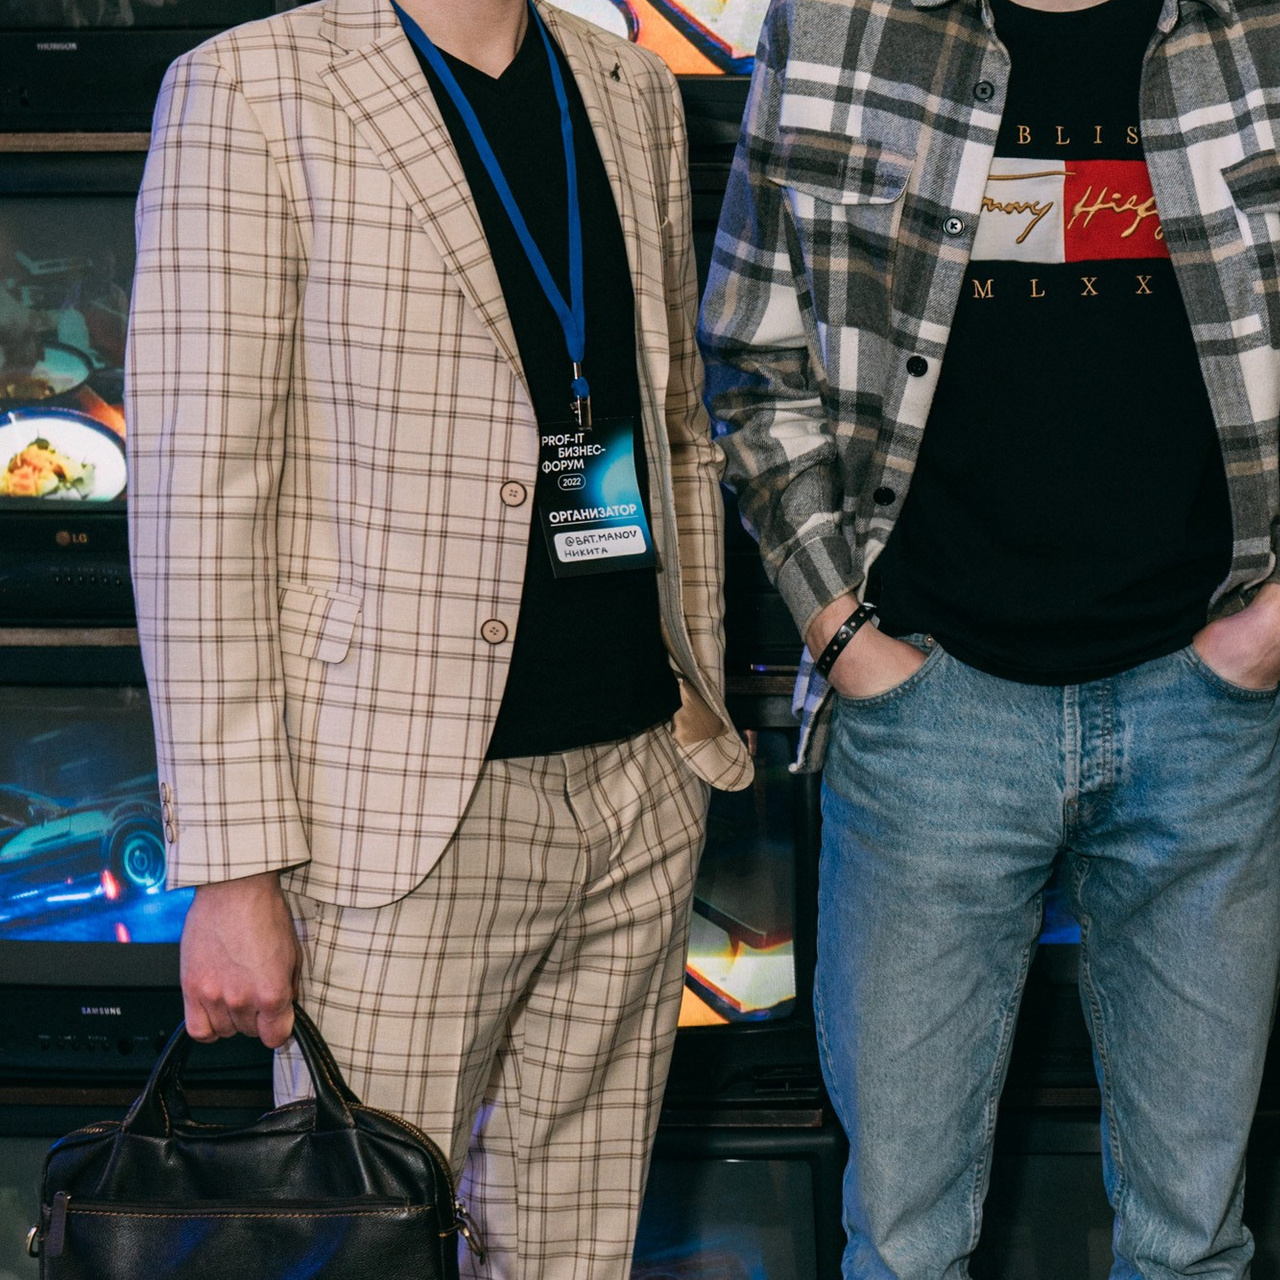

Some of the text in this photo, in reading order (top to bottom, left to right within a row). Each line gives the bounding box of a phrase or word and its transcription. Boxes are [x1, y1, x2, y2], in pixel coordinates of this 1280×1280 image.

[541, 432, 585, 447] PROF-IT
[558, 444, 606, 458] БИЗНЕС-
[541, 458, 585, 474] ФОРУМ
[562, 477, 582, 487] 2022
[549, 504, 637, 523] ОРГАНИЗАТОР
[73, 533, 87, 543] LG
[564, 547, 608, 558] НИКИТА
[81, 1007, 122, 1016] SAMSUNG
